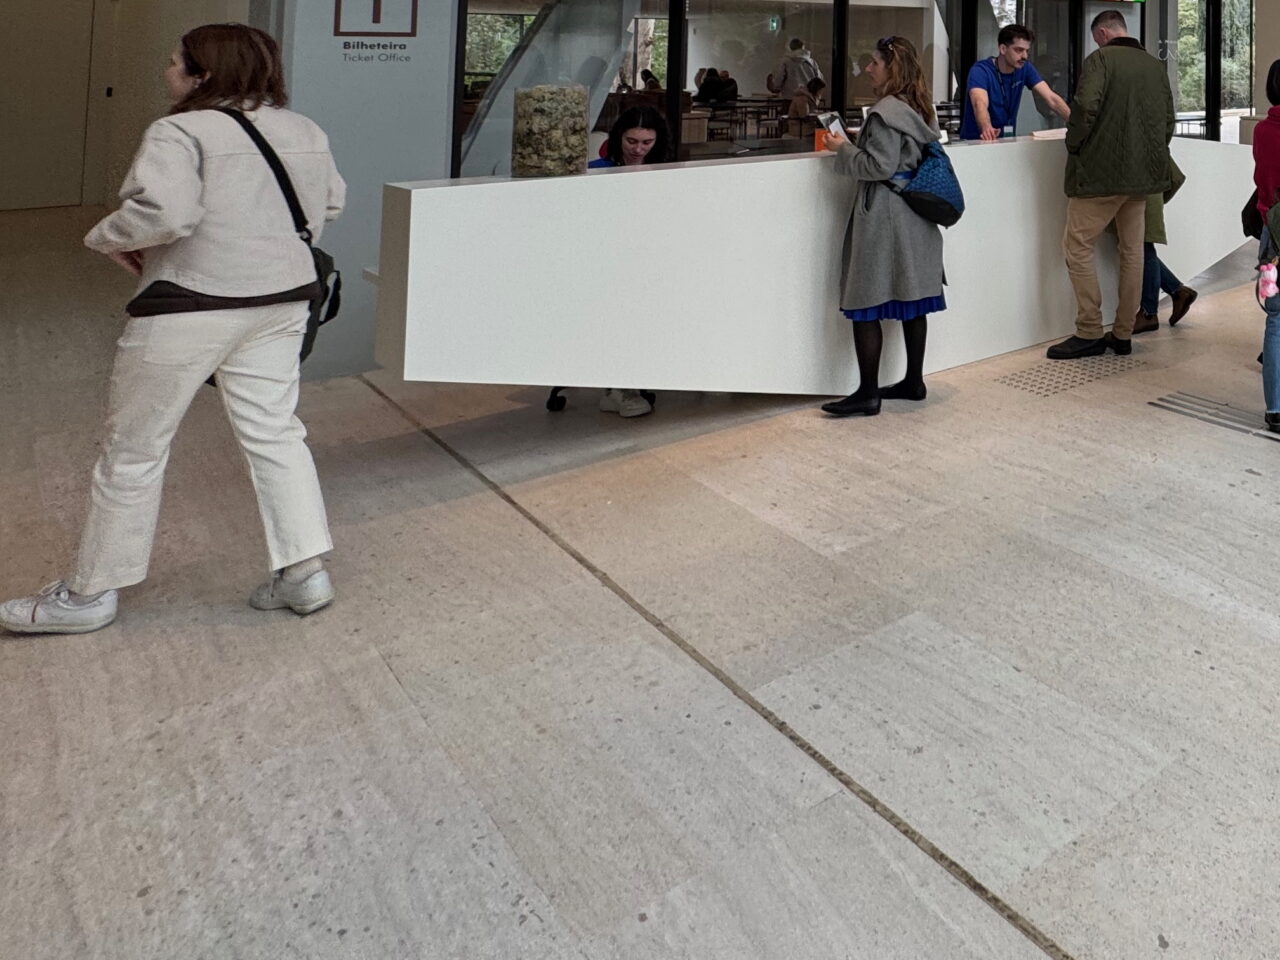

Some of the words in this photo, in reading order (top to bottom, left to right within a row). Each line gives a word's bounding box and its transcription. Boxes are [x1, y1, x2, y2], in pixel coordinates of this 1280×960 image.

[343, 41, 407, 50] Bilheteira
[343, 53, 374, 62] Ticket
[378, 53, 411, 62] Office
